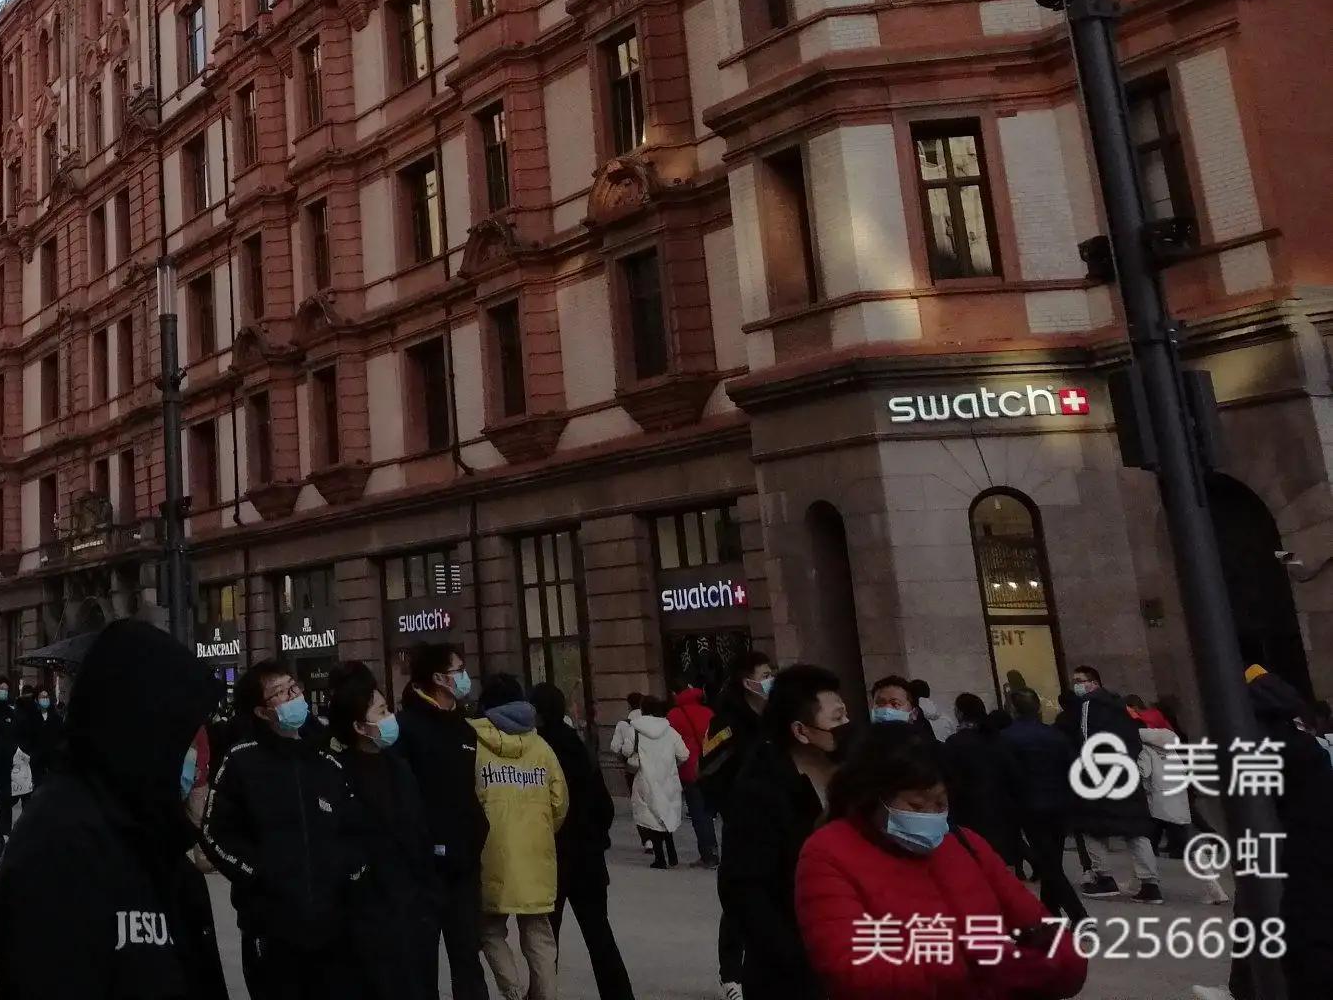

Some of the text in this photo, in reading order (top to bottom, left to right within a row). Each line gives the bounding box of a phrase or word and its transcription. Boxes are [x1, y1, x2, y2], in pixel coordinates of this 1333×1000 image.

[888, 385, 1057, 422] swatch
[661, 580, 733, 611] swatch
[398, 608, 443, 632] swatch
[196, 639, 241, 658] BLANCPAIN
[281, 629, 336, 651] BLANCPAIN
[481, 761, 546, 789] Hufflepuff
[115, 910, 174, 951] JESU
